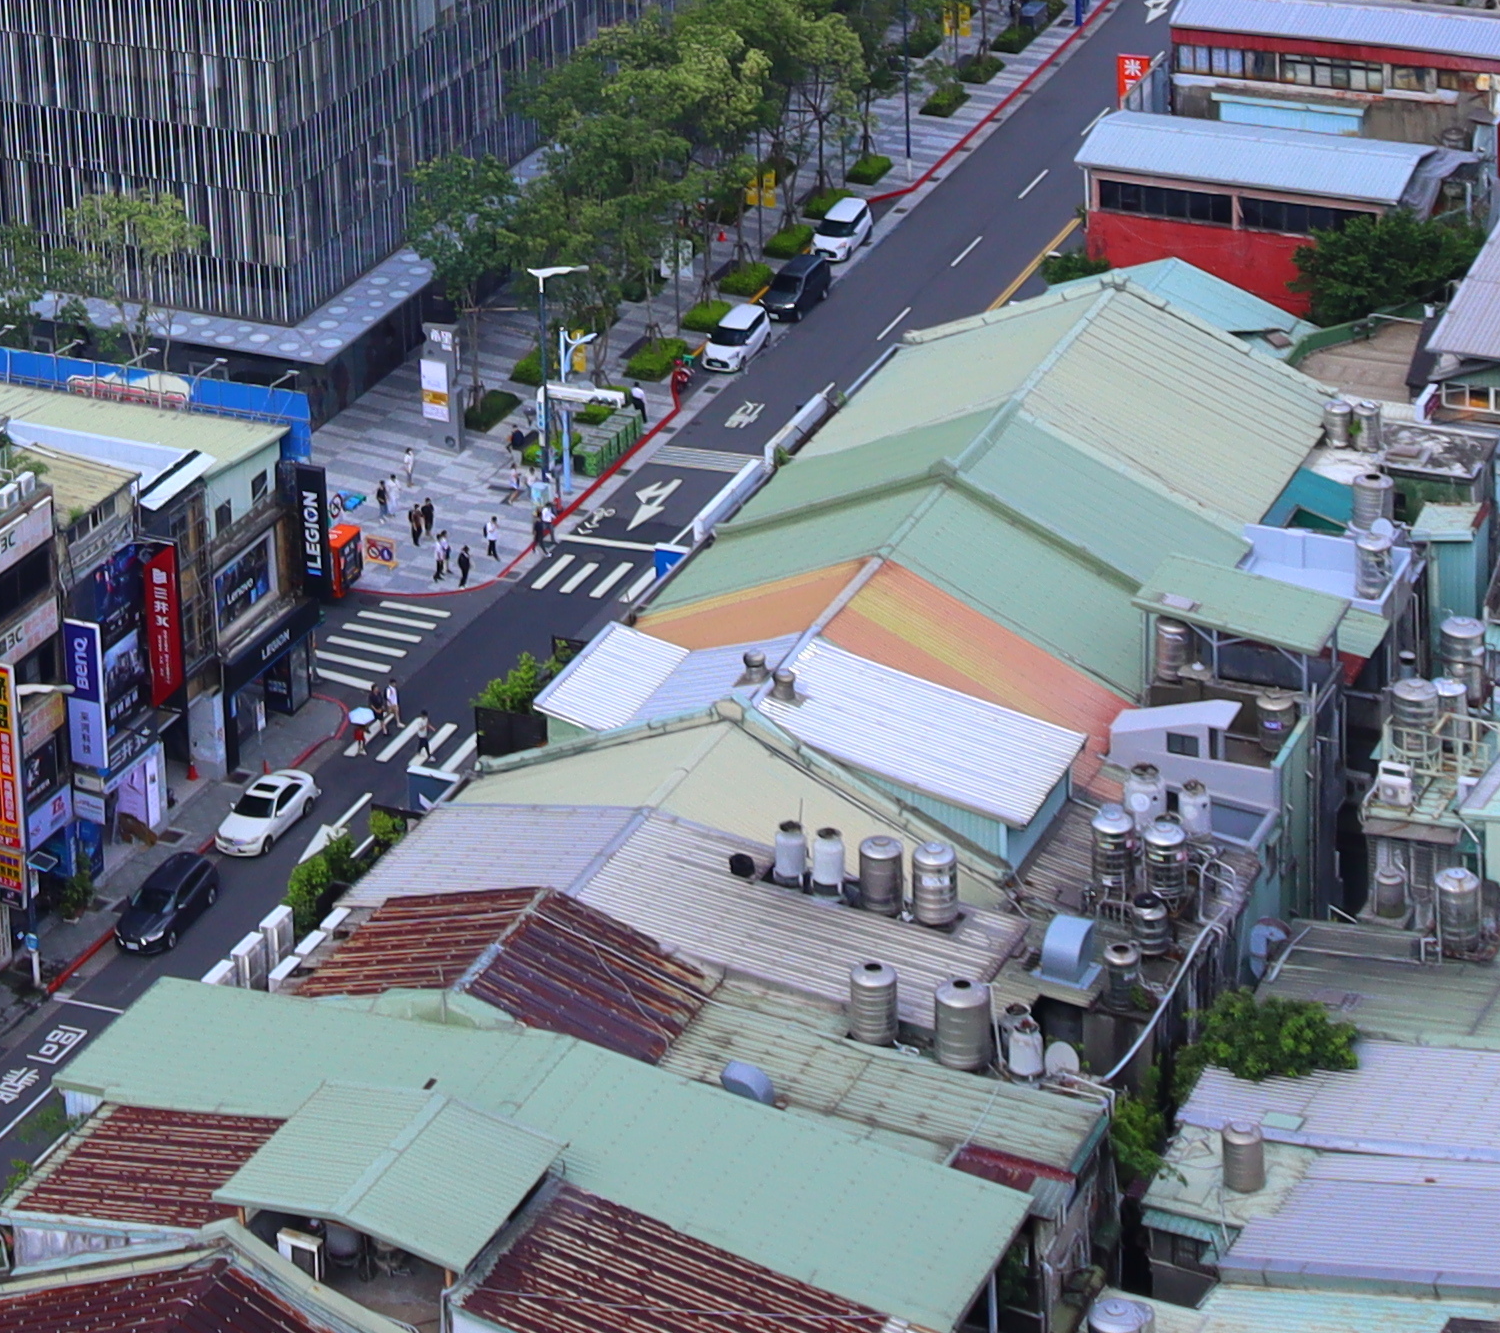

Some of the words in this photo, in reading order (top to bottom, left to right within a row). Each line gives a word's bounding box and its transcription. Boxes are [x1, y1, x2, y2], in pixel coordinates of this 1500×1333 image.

[301, 490, 323, 570] LEGION
[226, 577, 254, 606] Lenovo
[73, 636, 89, 691] BenQ
[261, 628, 291, 661] LEGION
